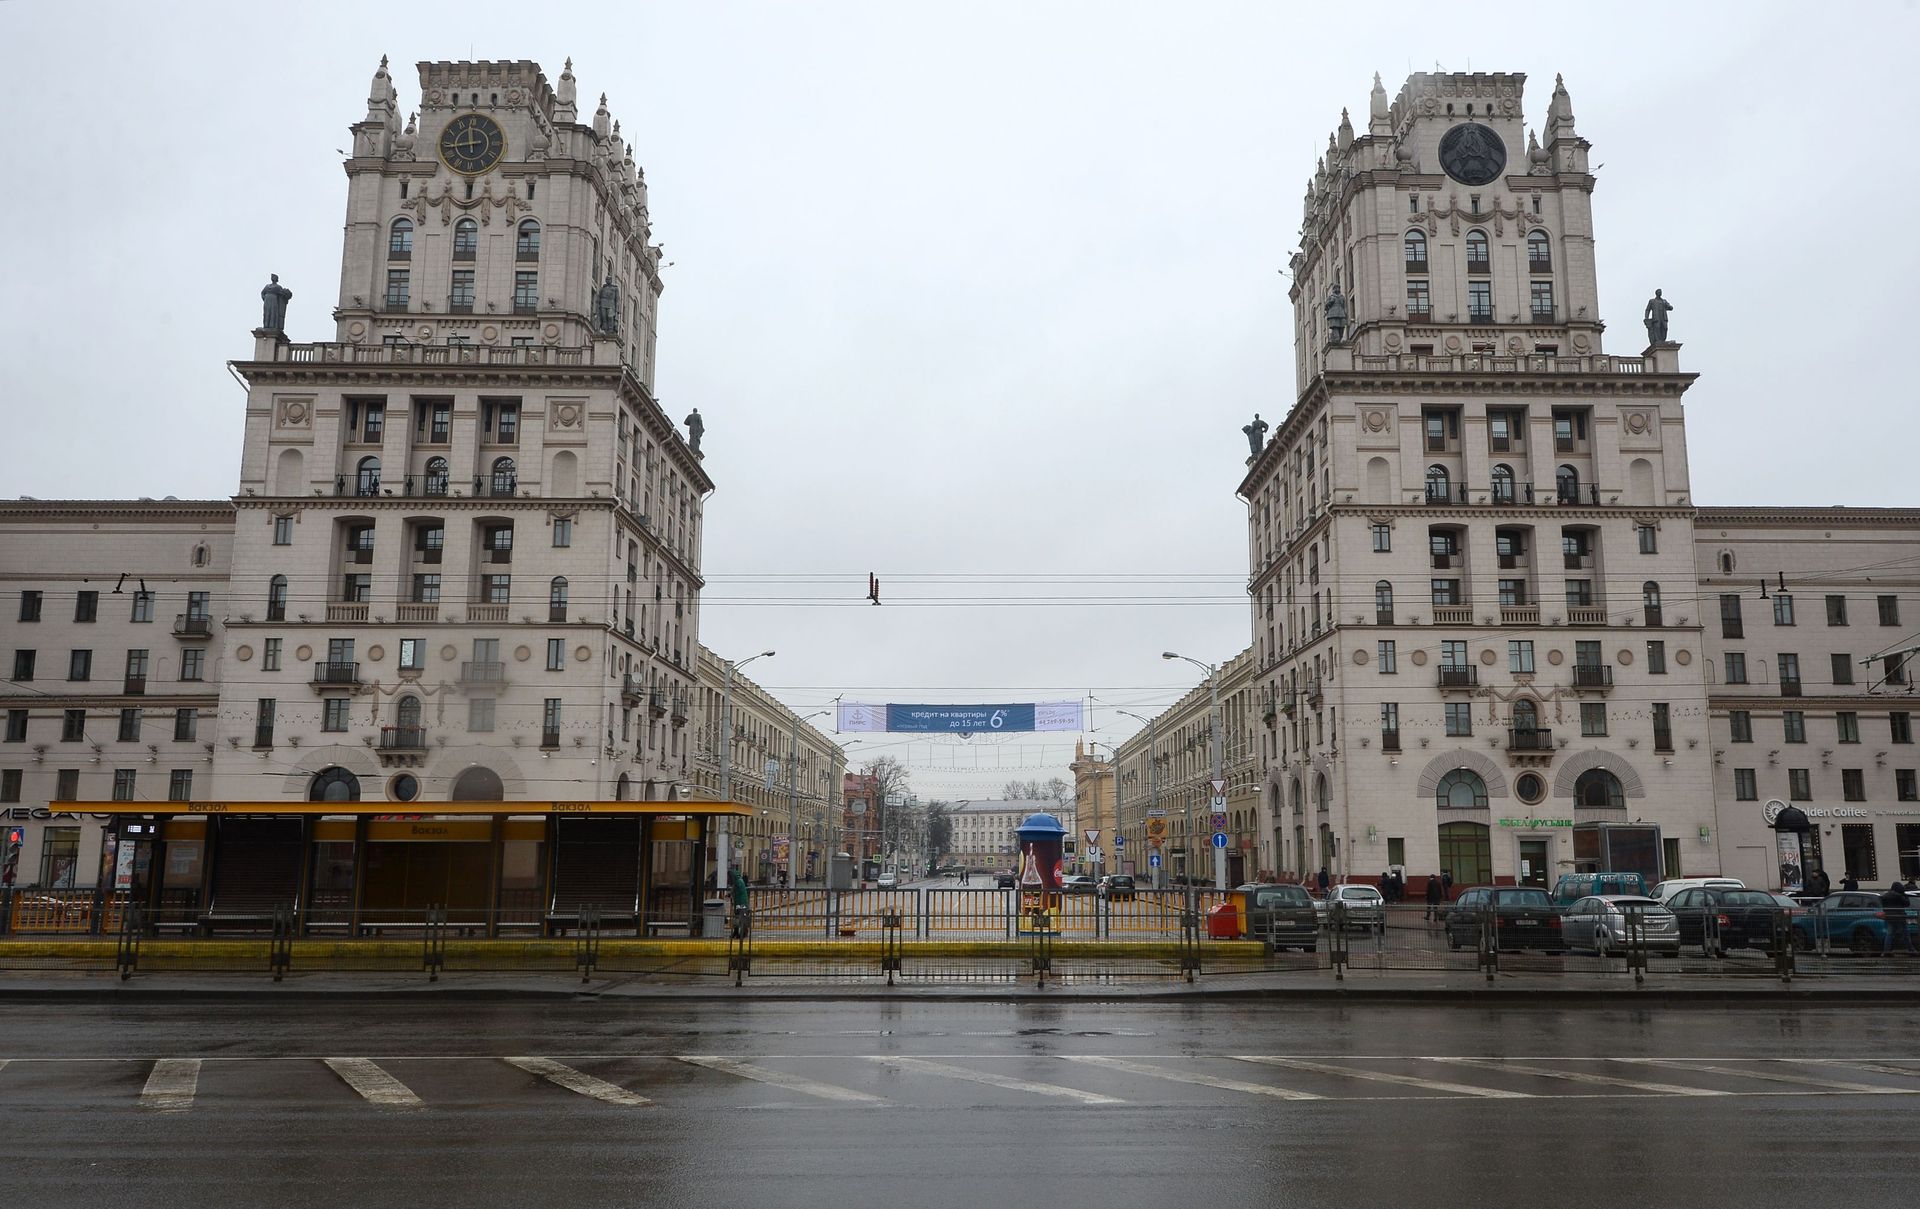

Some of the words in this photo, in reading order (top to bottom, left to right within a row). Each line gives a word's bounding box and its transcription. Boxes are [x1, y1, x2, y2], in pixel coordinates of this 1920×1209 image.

[911, 711, 938, 719] кредит
[950, 711, 987, 719] квартиры
[949, 720, 960, 728] до
[961, 719, 971, 727] 15
[1793, 806, 1830, 817] olden
[1832, 806, 1868, 817] Coffee
